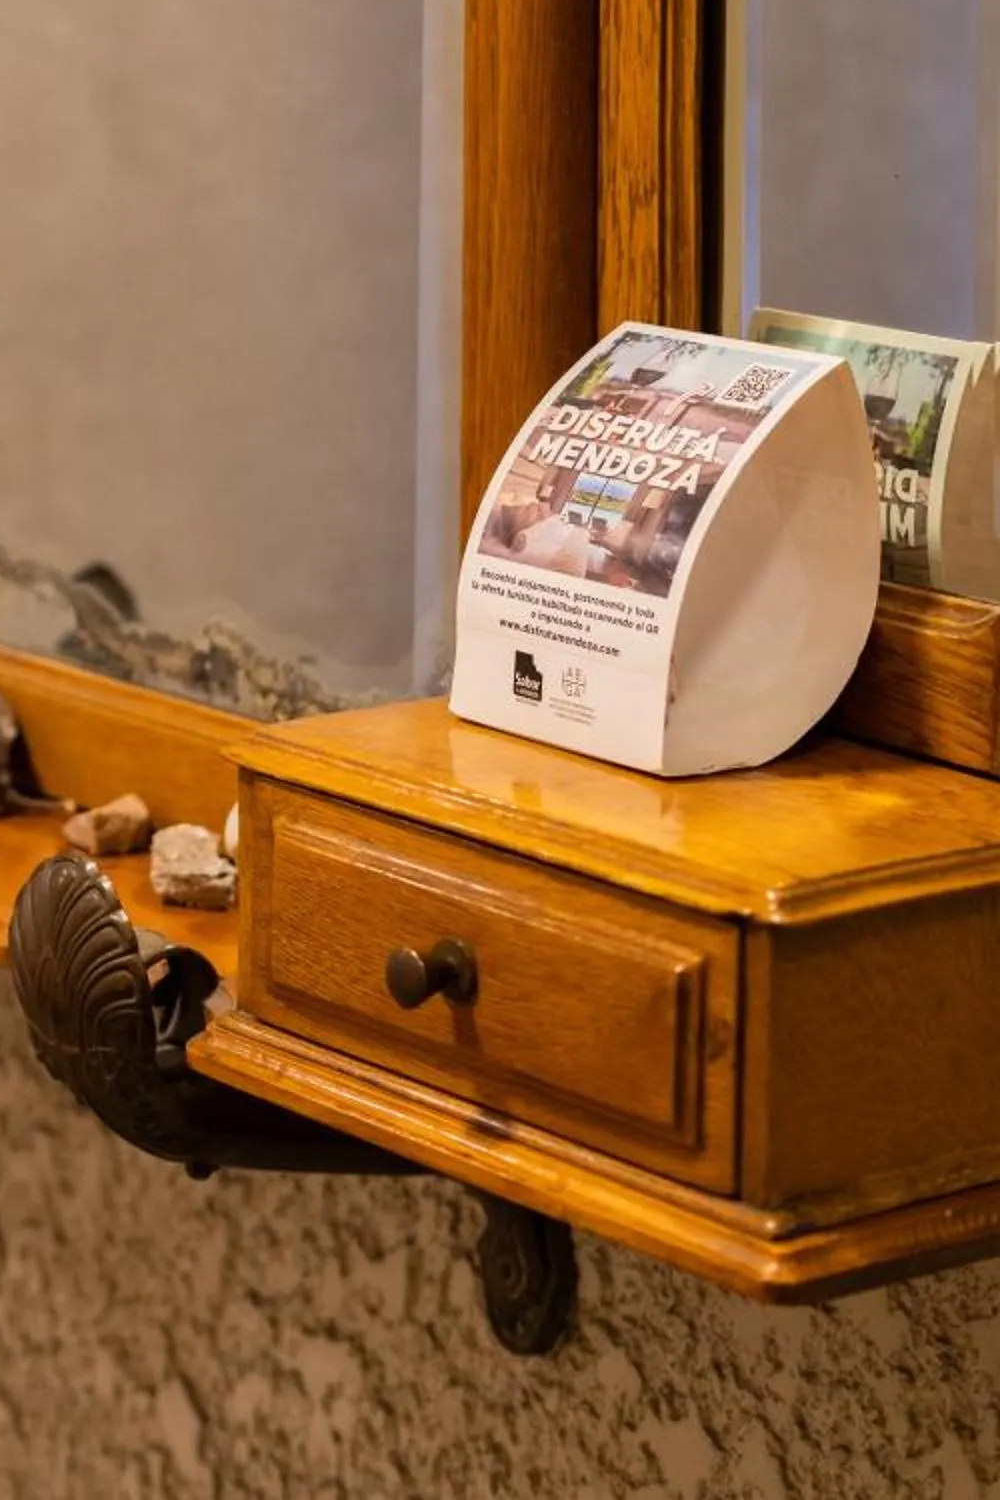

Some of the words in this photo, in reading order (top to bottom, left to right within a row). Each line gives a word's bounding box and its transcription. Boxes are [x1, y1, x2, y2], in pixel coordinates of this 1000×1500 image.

[529, 432, 702, 495] MENDOZA
[499, 619, 620, 657] www.disfrutamendoza.com
[646, 623, 659, 634] QR
